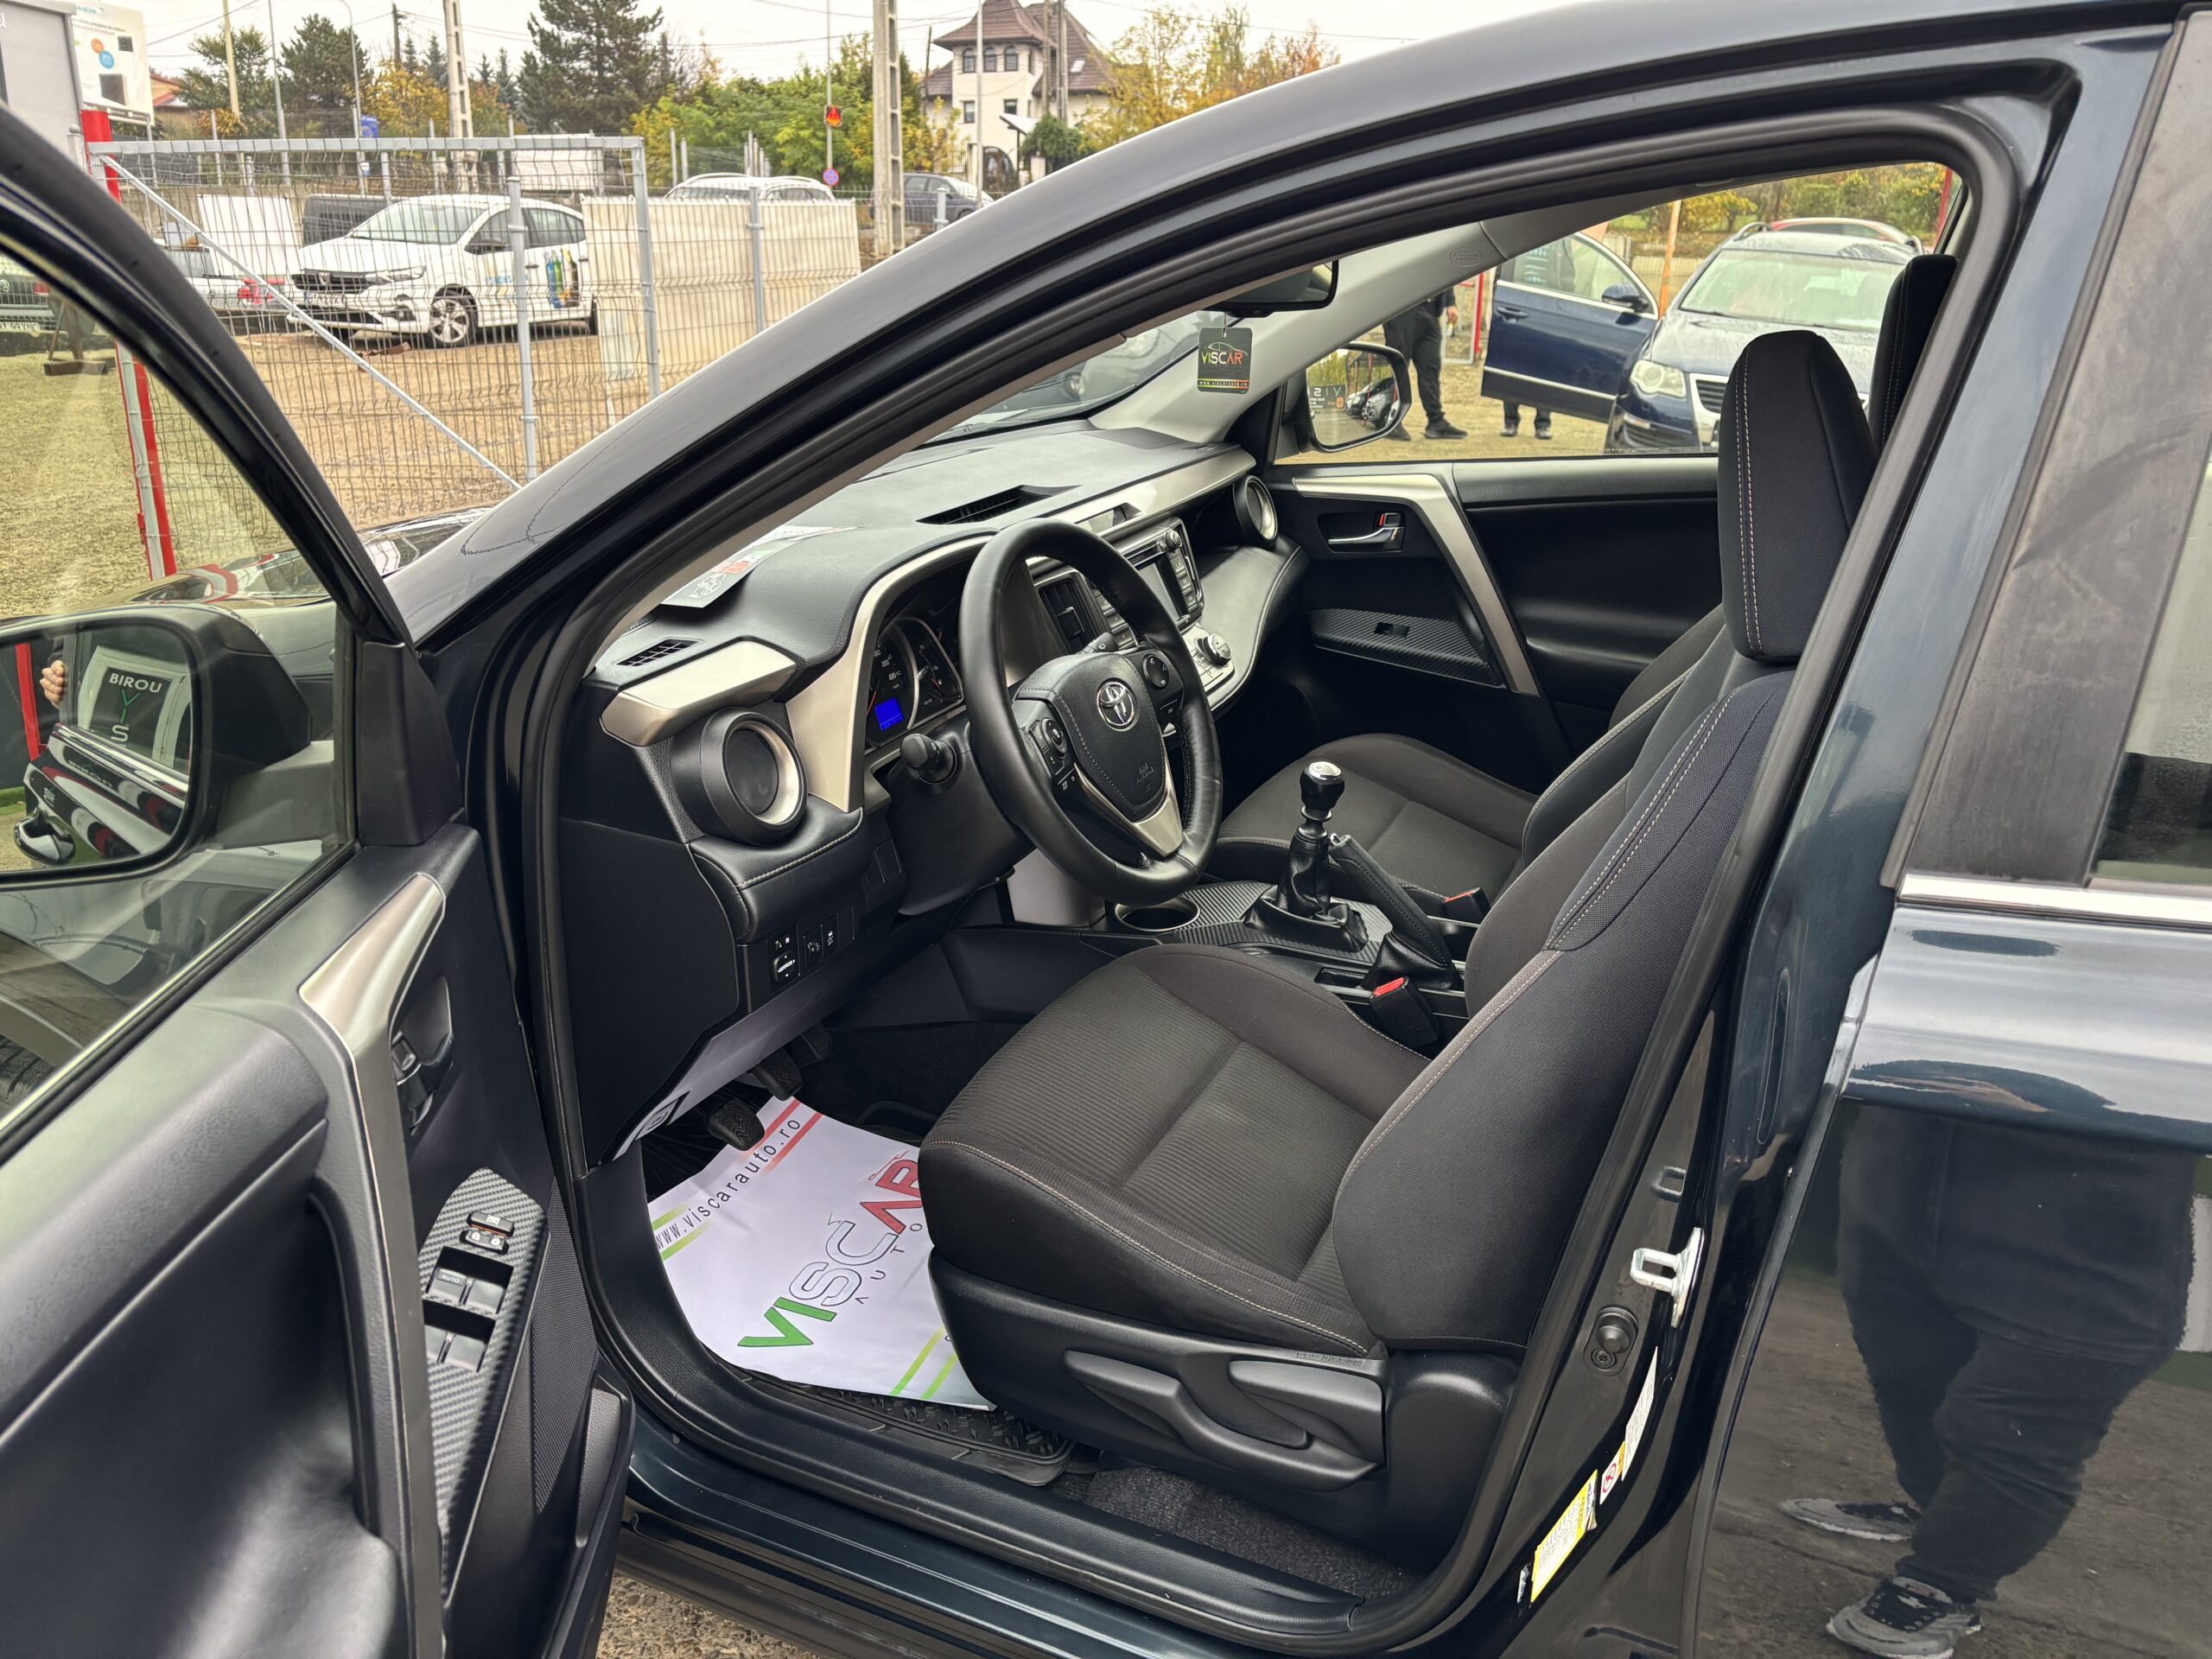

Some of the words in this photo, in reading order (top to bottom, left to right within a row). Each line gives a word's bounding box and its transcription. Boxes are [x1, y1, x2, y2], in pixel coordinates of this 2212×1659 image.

[76, 5, 97, 15] AIKIN
[1201, 352, 1243, 365] VISCAR
[109, 672, 162, 693] BIROU
[655, 1119, 801, 1250] www.viscarauto.ro
[737, 1160, 923, 1347] VISCAR
[442, 1274, 460, 1283] AUTO
